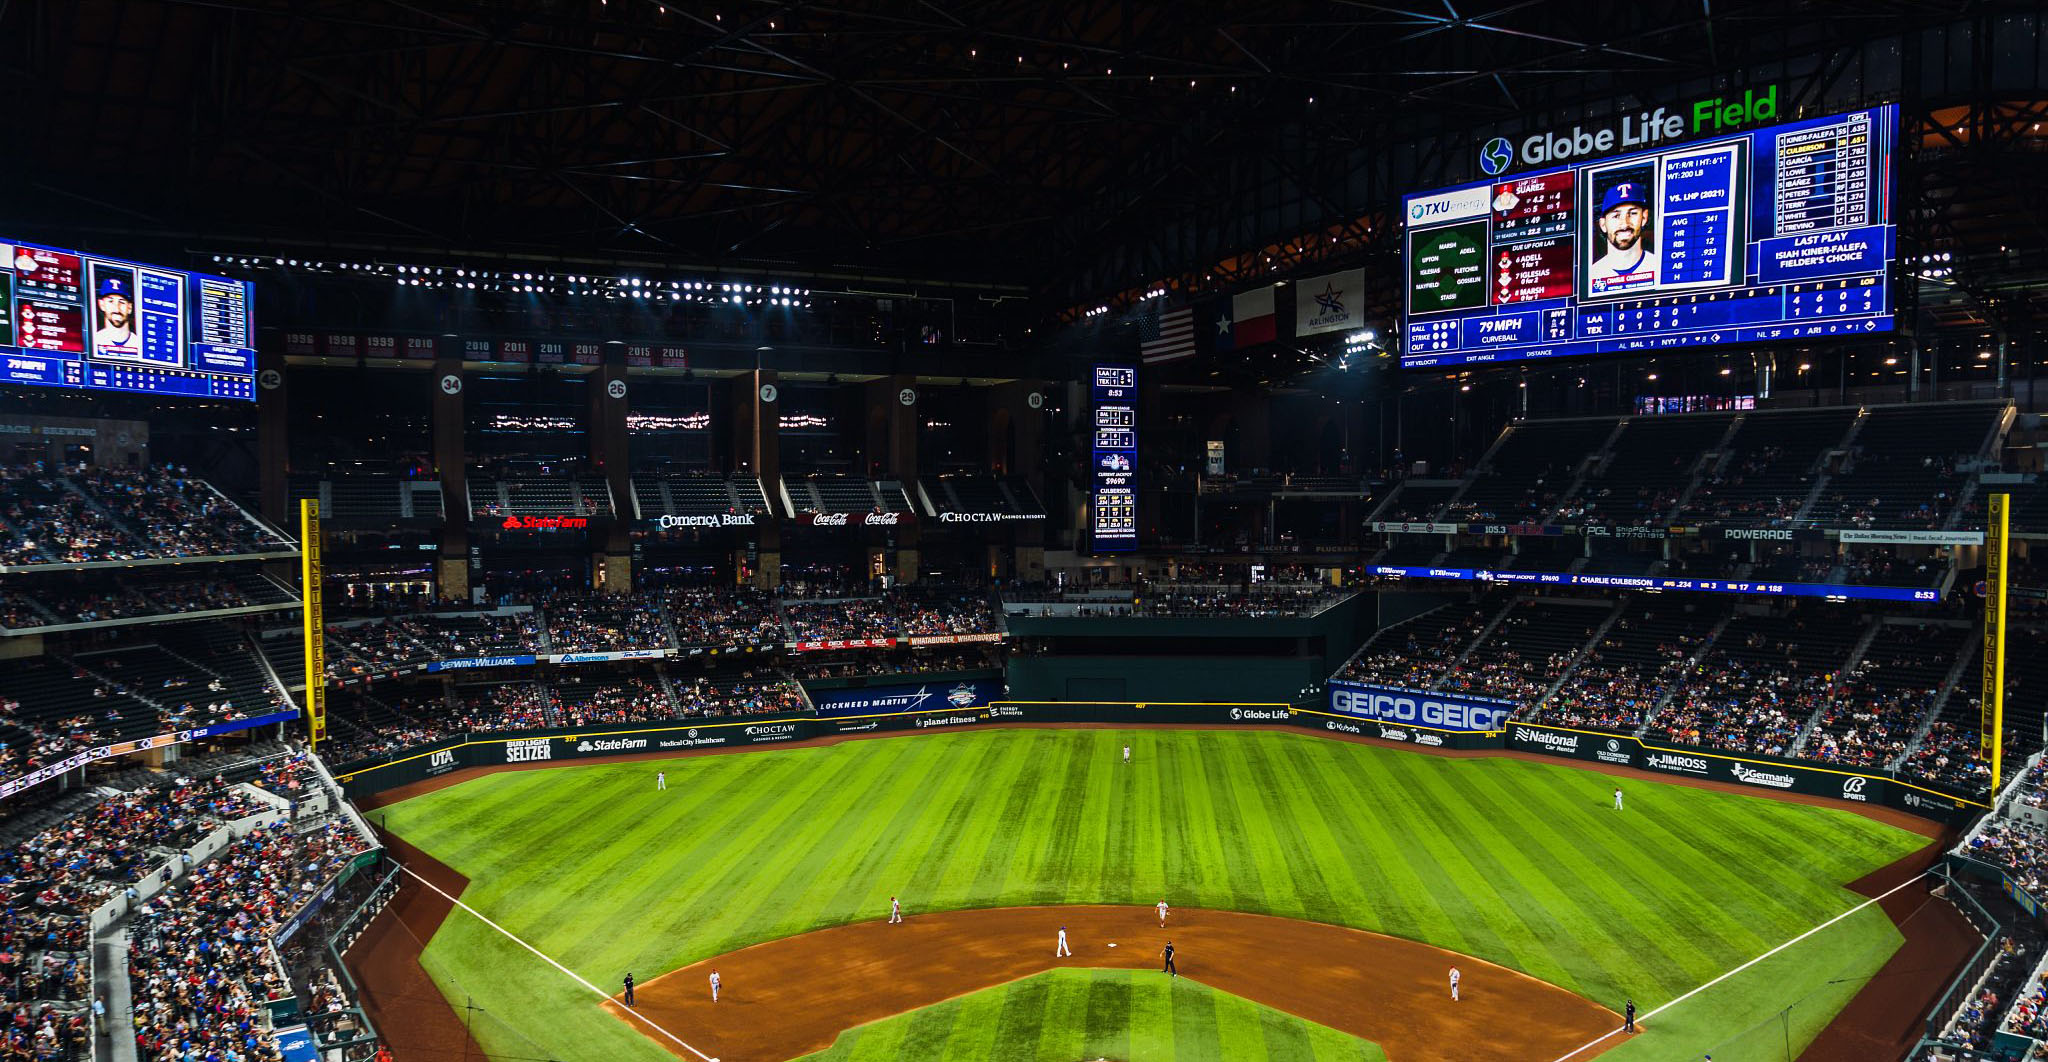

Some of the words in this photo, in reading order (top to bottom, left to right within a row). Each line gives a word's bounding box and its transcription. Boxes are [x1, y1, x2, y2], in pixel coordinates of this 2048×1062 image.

[1521, 126, 1614, 164] Globe
[1622, 107, 1684, 146] Life
[1693, 85, 1776, 133] Field
[1787, 130, 1834, 143] KINER-FALEFA
[1786, 143, 1825, 155] CULBERSON
[1786, 168, 1806, 176] LOWE
[1700, 189, 1724, 199] (2021)
[1785, 190, 1810, 198] PETERS
[1426, 201, 1449, 215] TXU
[1785, 201, 1806, 209] TERRY
[1785, 212, 1806, 220] WHITE
[1785, 222, 1814, 230] TREVINO
[1795, 236, 1819, 246] LAST
[1821, 232, 1848, 243] PLAY
[1776, 249, 1799, 259] ISIAH
[1801, 242, 1867, 256] KINER-FALEFA
[1521, 254, 1542, 262] ADELL
[1780, 256, 1824, 268] FIELDER'S
[1826, 252, 1862, 263] CHOICE
[1520, 269, 1550, 278] IGLESIAS
[1520, 287, 1544, 295] MARSH
[1309, 314, 1349, 326] ARLINGTON
[1480, 321, 1493, 333] 79
[1495, 318, 1522, 332] MPH
[408, 339, 433, 348] 2010
[1482, 334, 1517, 344] CURVEBALL
[466, 341, 489, 350] 2010
[505, 342, 527, 352] 2011
[541, 344, 562, 353] 2011
[576, 345, 599, 354] 2012
[629, 347, 650, 357] 2015
[663, 349, 684, 358] 2016
[261, 373, 279, 386] 42
[444, 380, 459, 390] 34
[610, 384, 624, 394] 26
[765, 388, 772, 398] 7
[901, 391, 914, 402] 29
[1030, 396, 1040, 405] 10
[722, 513, 754, 525] Bank
[813, 513, 848, 526] Coca-Cola
[865, 512, 899, 526] Coca-Cola
[946, 512, 1001, 521] CHOCTAW
[1485, 526, 1506, 534] 105.3
[1587, 527, 1610, 535] PGL
[1726, 530, 1793, 540] POWERADE
[1580, 576, 1608, 584] CHARLIE
[1610, 578, 1653, 586] CULBERSON
[1915, 590, 1935, 600] 8:53
[912, 636, 954, 645] WHATABURGER
[957, 634, 999, 642] WHATABURGER
[821, 700, 868, 710] LOCKHEED
[872, 697, 908, 706] MARTIN
[1332, 690, 1415, 720] GEICO
[1244, 710, 1270, 719] Globe
[1272, 710, 1289, 718] Life
[1422, 701, 1510, 732] GEICO
[924, 718, 948, 728] planet
[950, 716, 976, 724] fitness
[751, 725, 795, 734] CHOCTAW
[1336, 723, 1360, 733] Kubota
[682, 739, 694, 747] City
[695, 737, 725, 745] Healthcare
[431, 750, 453, 767] UTA
[507, 745, 551, 762] SELTZER
[1748, 770, 1794, 784] Germania
[1843, 792, 1866, 801] SPORTS
